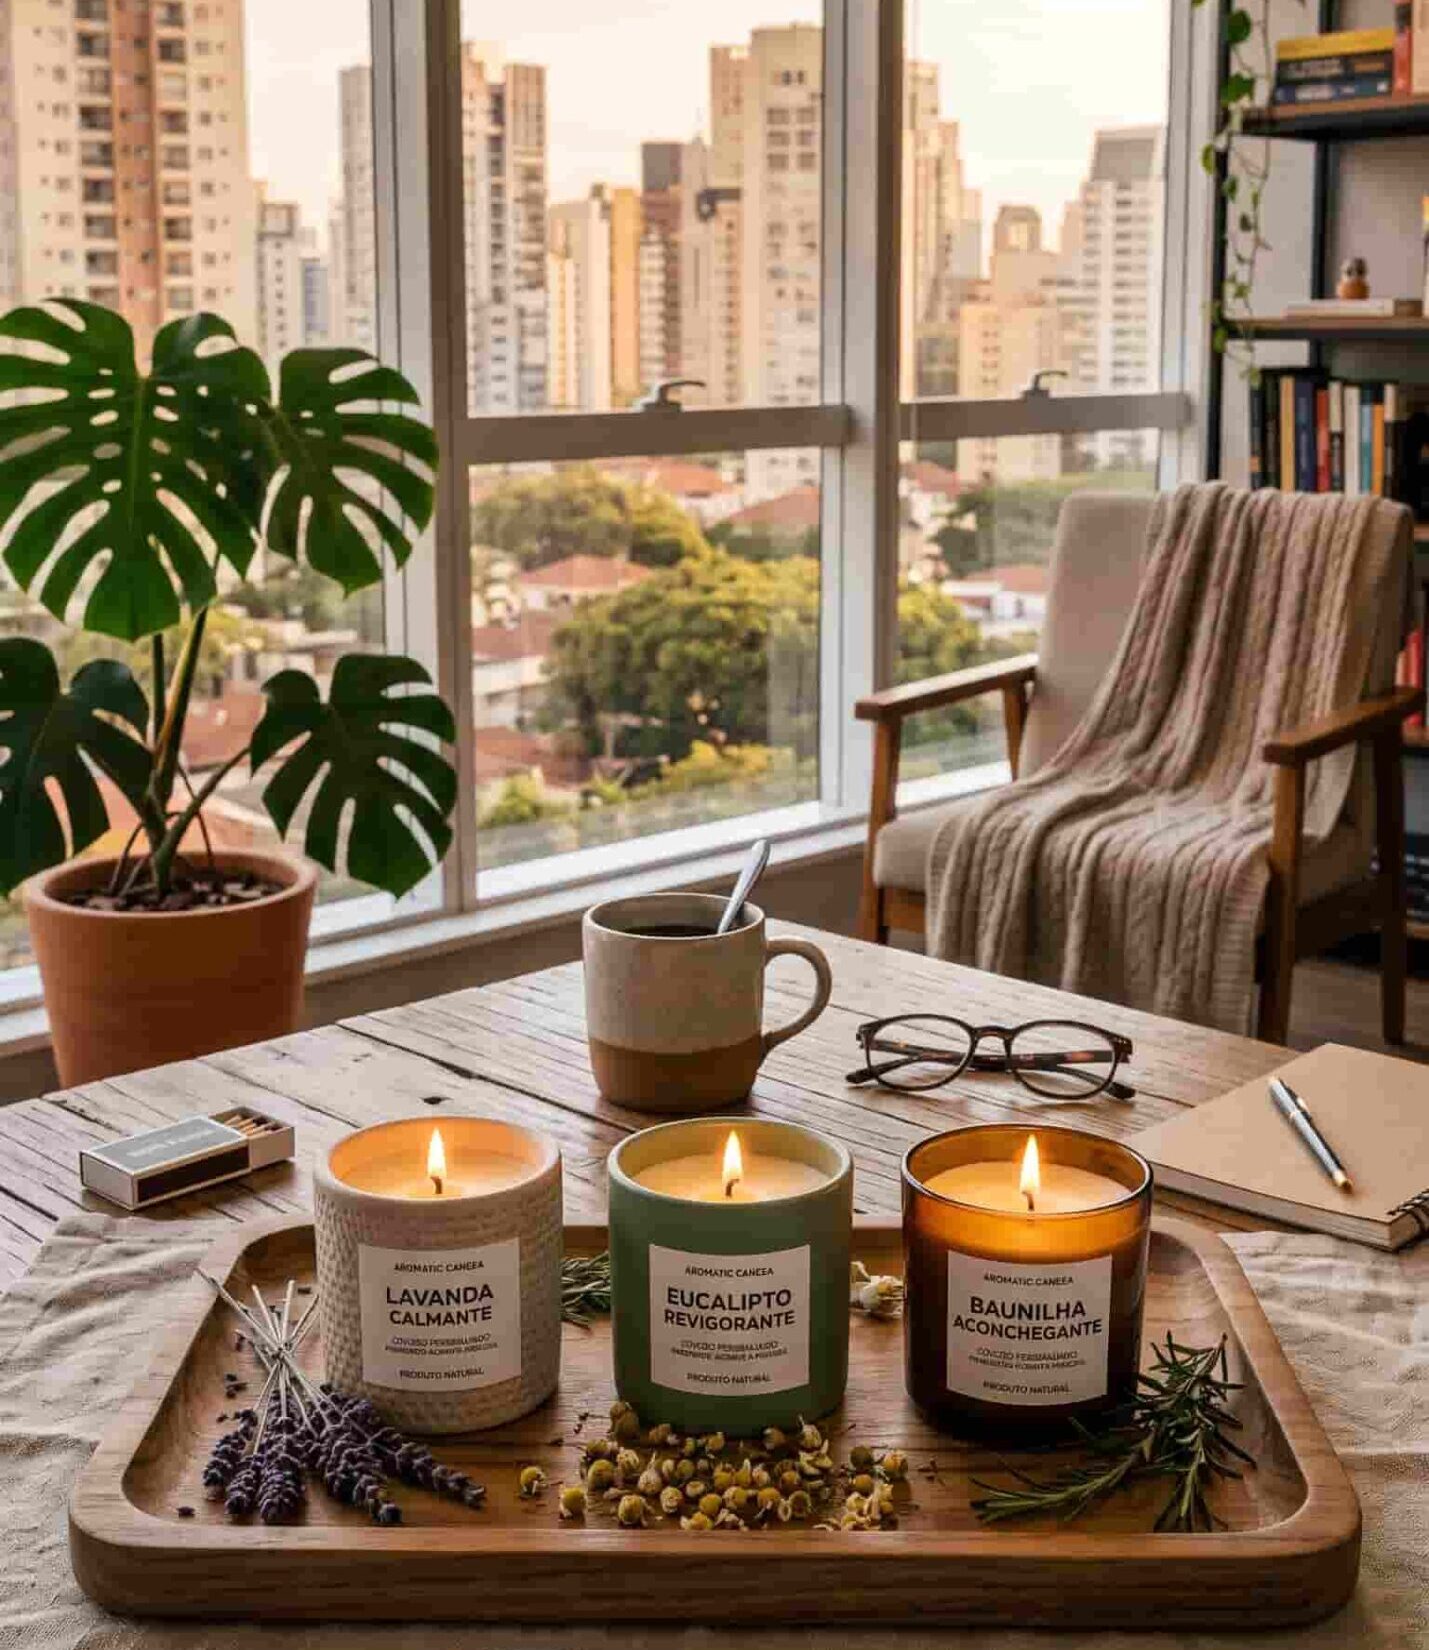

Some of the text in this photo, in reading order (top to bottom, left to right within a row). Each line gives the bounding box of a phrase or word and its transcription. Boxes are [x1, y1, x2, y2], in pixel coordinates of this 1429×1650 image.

[386, 1284, 494, 1306] LAVANDA
[667, 1286, 792, 1311] EUCALIPTO
[389, 1306, 492, 1326] CALMANTE
[970, 1296, 1086, 1321] BAUNILHA
[664, 1309, 795, 1331] REVIGORANTE
[952, 1314, 1103, 1340] ACONCHEGANTE
[399, 1367, 484, 1380] PRODUTO NATURAL
[983, 1380, 1071, 1394] PRODUTO NATURAL
